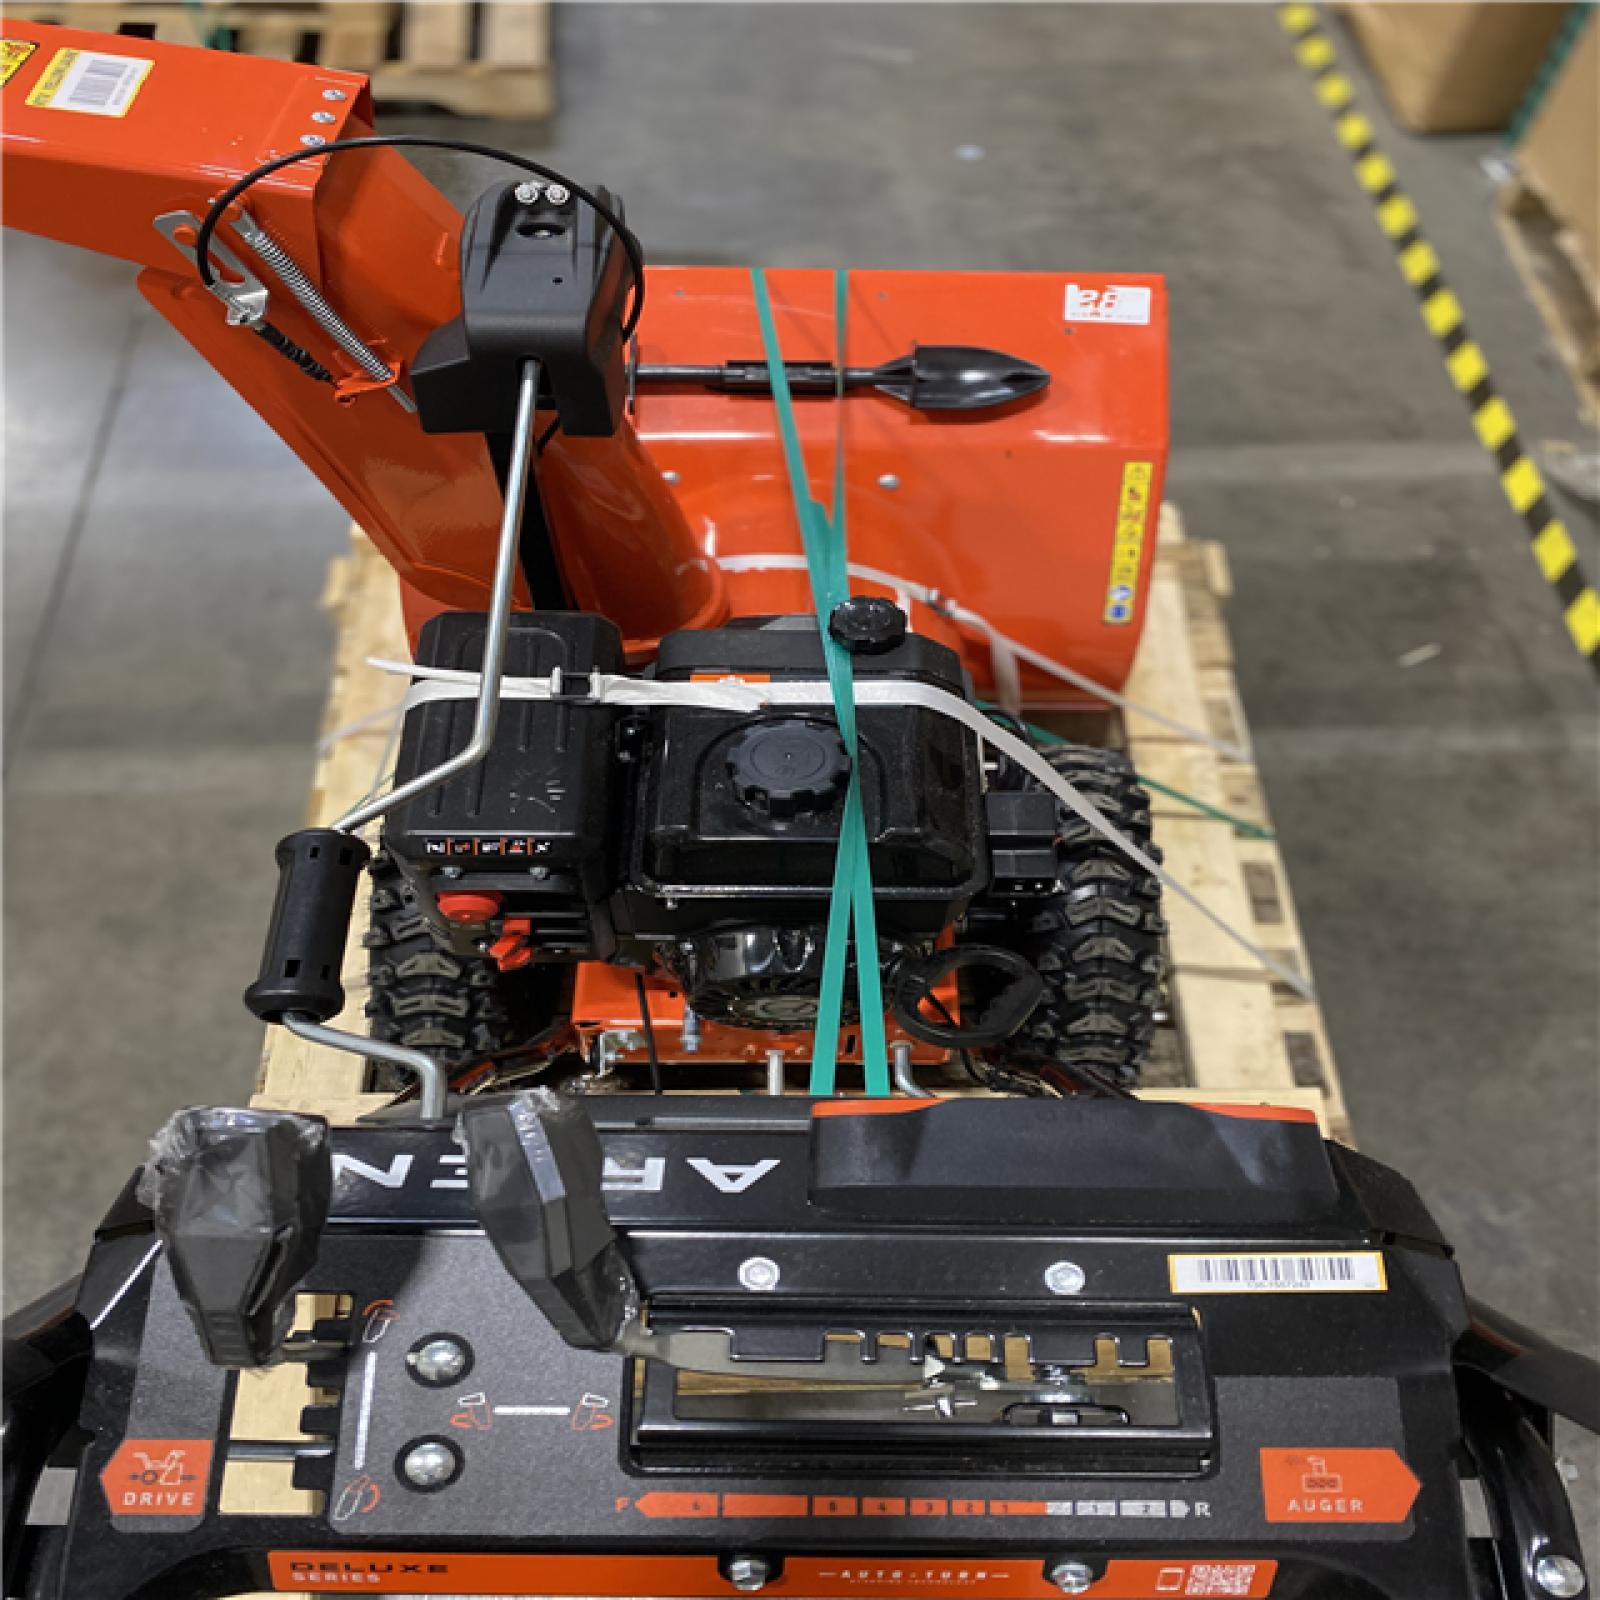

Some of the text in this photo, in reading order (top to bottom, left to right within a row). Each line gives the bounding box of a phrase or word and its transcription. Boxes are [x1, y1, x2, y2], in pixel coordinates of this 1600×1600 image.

[122, 1491, 197, 1507] DRIVE
[1287, 1498, 1364, 1514] AUGER
[1194, 1501, 1212, 1517] R
[290, 1561, 449, 1573] DELUXE
[292, 1572, 381, 1583] SERIES
